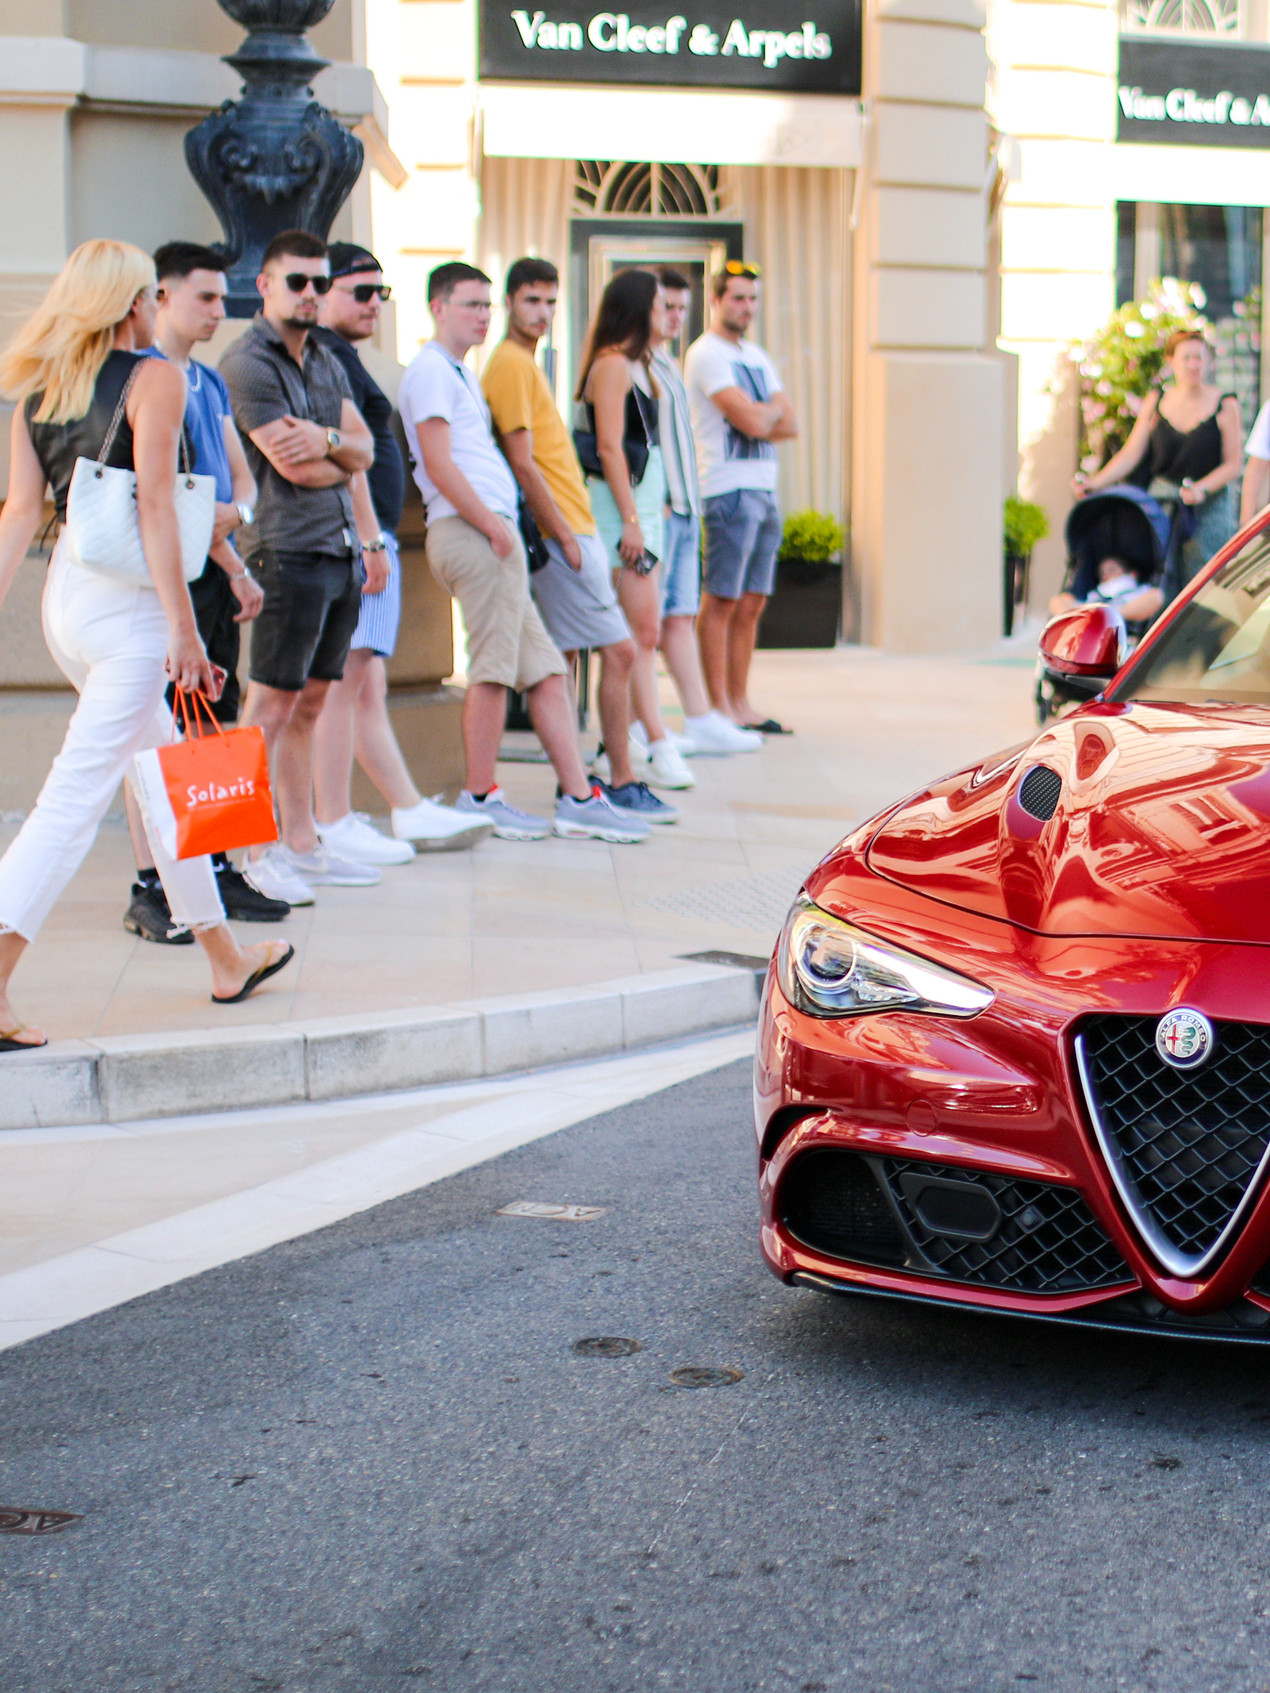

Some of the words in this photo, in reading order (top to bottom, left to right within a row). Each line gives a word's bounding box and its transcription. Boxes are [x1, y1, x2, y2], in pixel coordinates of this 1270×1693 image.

[510, 10, 584, 50] Van
[587, 12, 688, 54] Cleef
[688, 24, 720, 55] &
[720, 18, 832, 68] Arpels
[1118, 85, 1166, 121] Van
[1166, 87, 1233, 124] Cleef
[1229, 97, 1251, 125] &
[186, 776, 256, 808] Solaris
[1160, 1016, 1178, 1038] ALFA
[1181, 1015, 1206, 1042] ROMEO
